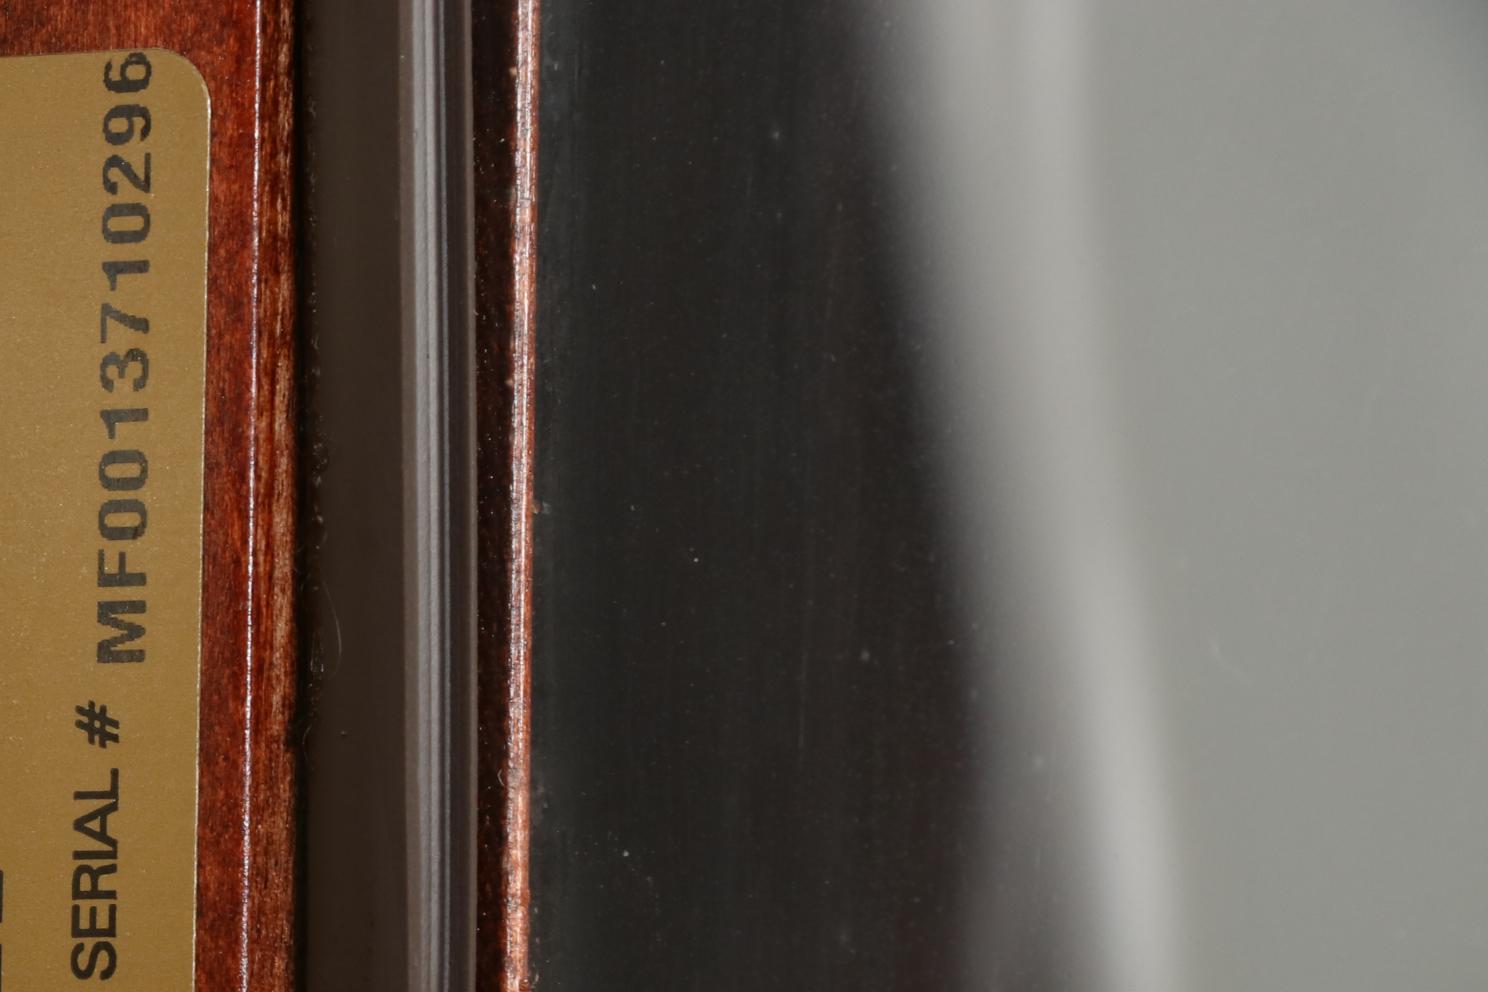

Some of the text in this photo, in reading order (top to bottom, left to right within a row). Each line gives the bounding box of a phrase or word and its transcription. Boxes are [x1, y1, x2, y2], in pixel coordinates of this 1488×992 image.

[97, 51, 152, 664] MF0013710296
[75, 700, 120, 749] #
[70, 768, 119, 981] SERIAL
